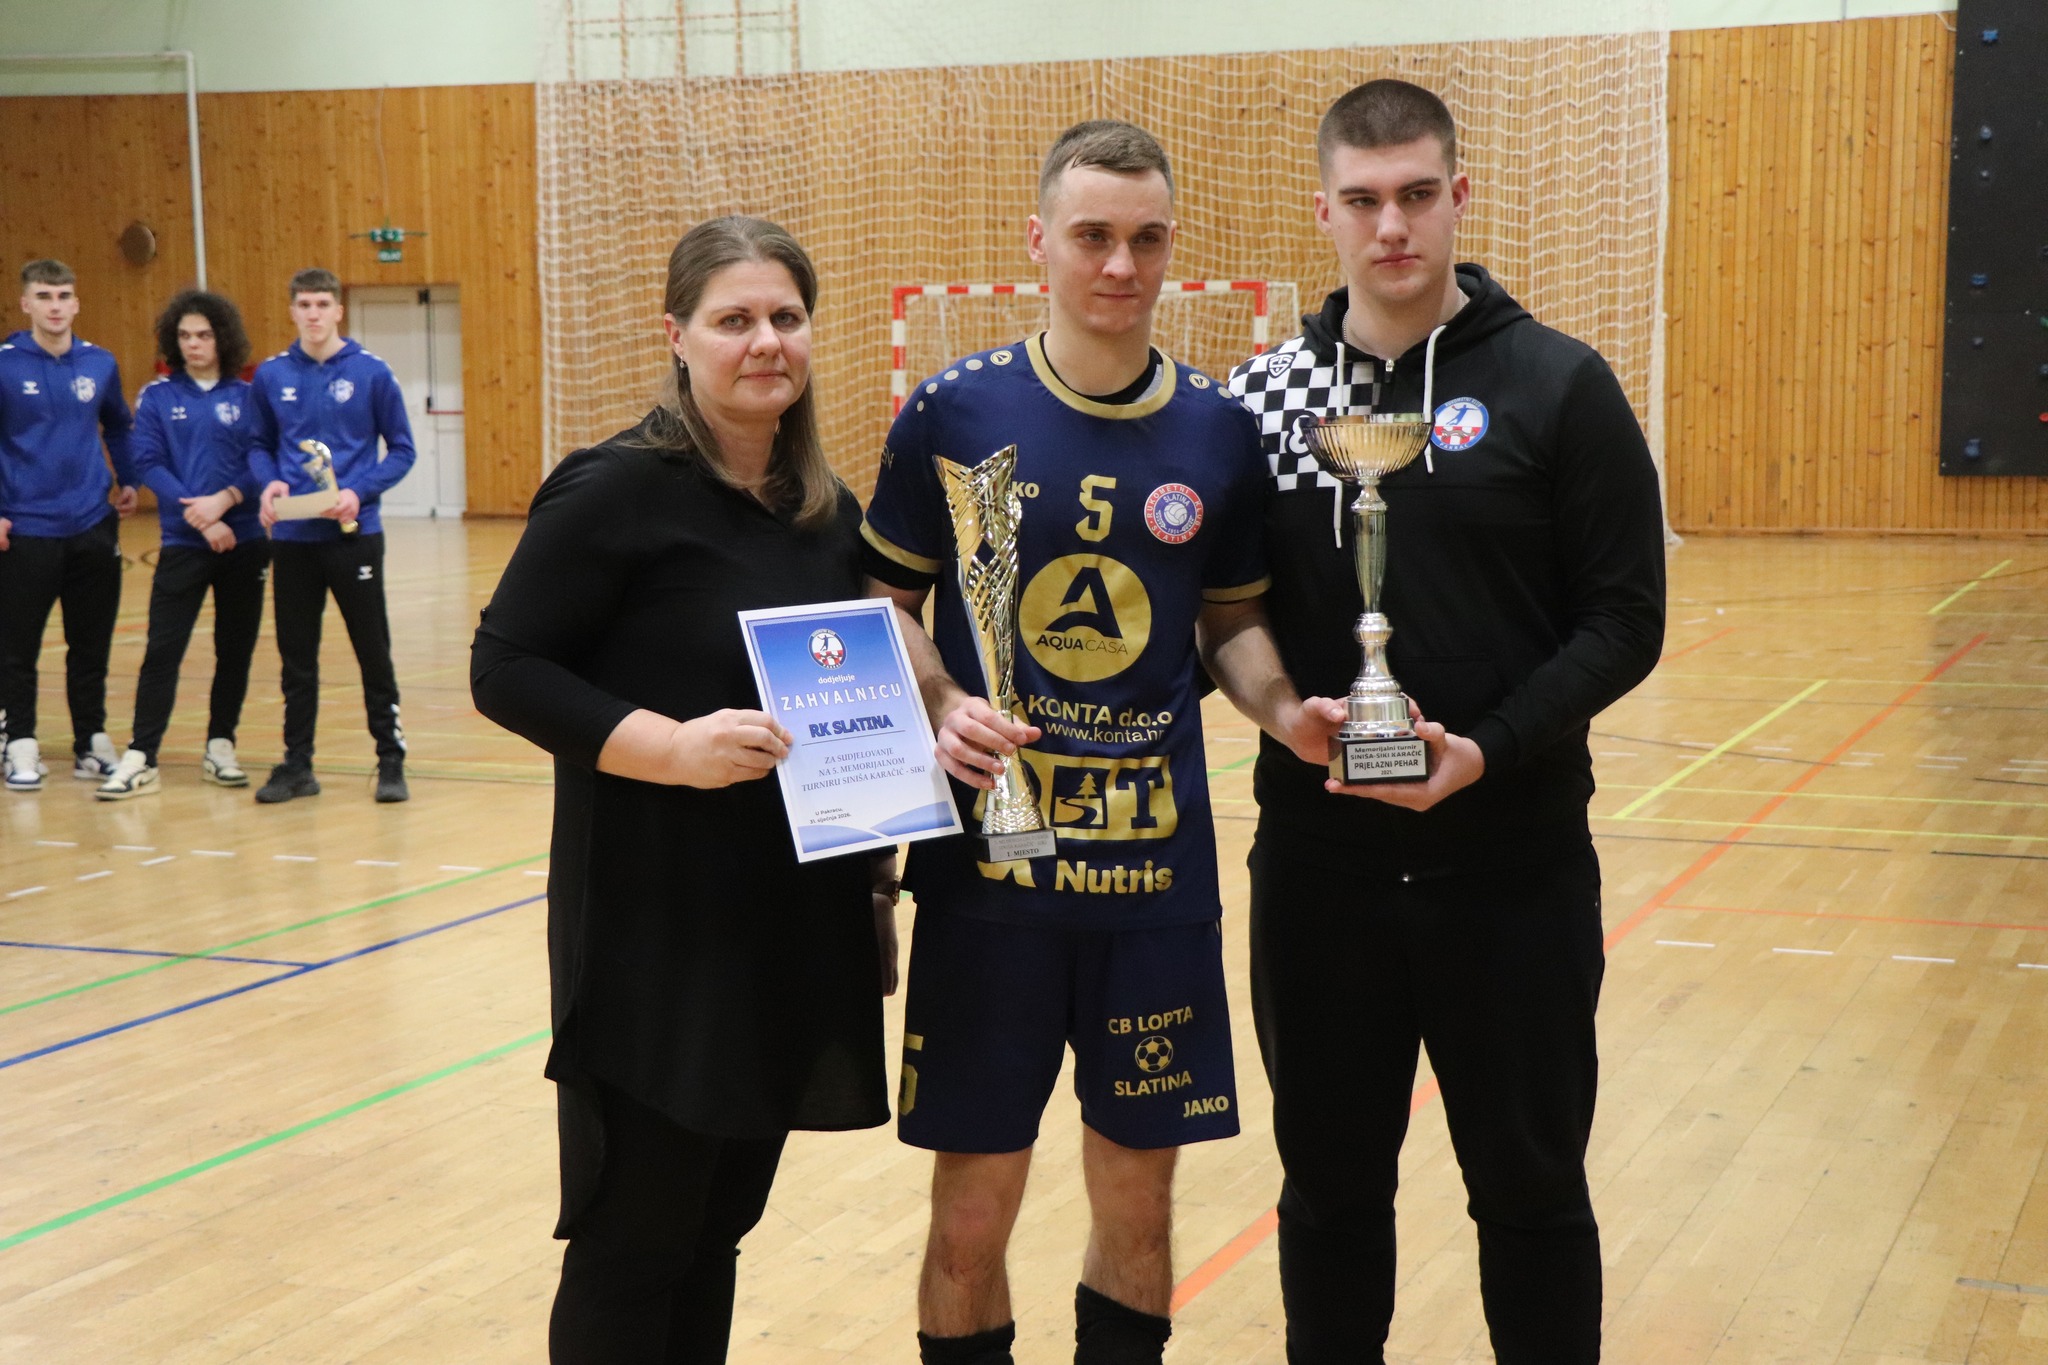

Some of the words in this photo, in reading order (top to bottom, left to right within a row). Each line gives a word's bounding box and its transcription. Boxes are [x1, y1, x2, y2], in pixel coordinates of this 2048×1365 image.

[1074, 474, 1117, 543] 5
[1146, 485, 1189, 519] RUKOMETNI
[1163, 493, 1191, 507] SLATINA
[1151, 525, 1194, 542] SLATINA
[818, 673, 856, 685] dodjeljuje
[780, 682, 902, 711] ZAHVALNICU
[1028, 694, 1112, 726] KONTA
[1118, 707, 1174, 728] d.o.o
[808, 721, 831, 738] RK
[832, 714, 894, 735] SLATINA
[1045, 721, 1165, 744] www.konta.hr
[824, 754, 836, 765] ZA
[838, 747, 894, 763] SUDJELOVANJE
[1355, 745, 1396, 753] Memorijalni
[818, 768, 831, 778] NA
[832, 766, 839, 775] 5.
[840, 757, 906, 774] MEMORIJALNOM
[1354, 761, 1393, 770] PRJELAZNI
[801, 776, 841, 792] TURNIRU
[842, 772, 869, 785] SINIŠA
[870, 766, 904, 781] KARAČIĆ
[910, 765, 926, 775] SIKI
[1013, 848, 1040, 857] MJESTO
[1054, 859, 1174, 894] Nutris
[1107, 1017, 1132, 1035] CB
[1137, 1005, 1194, 1033] LOPTA
[1114, 1069, 1193, 1097] SLATINA
[1182, 1095, 1230, 1118] JAKO
